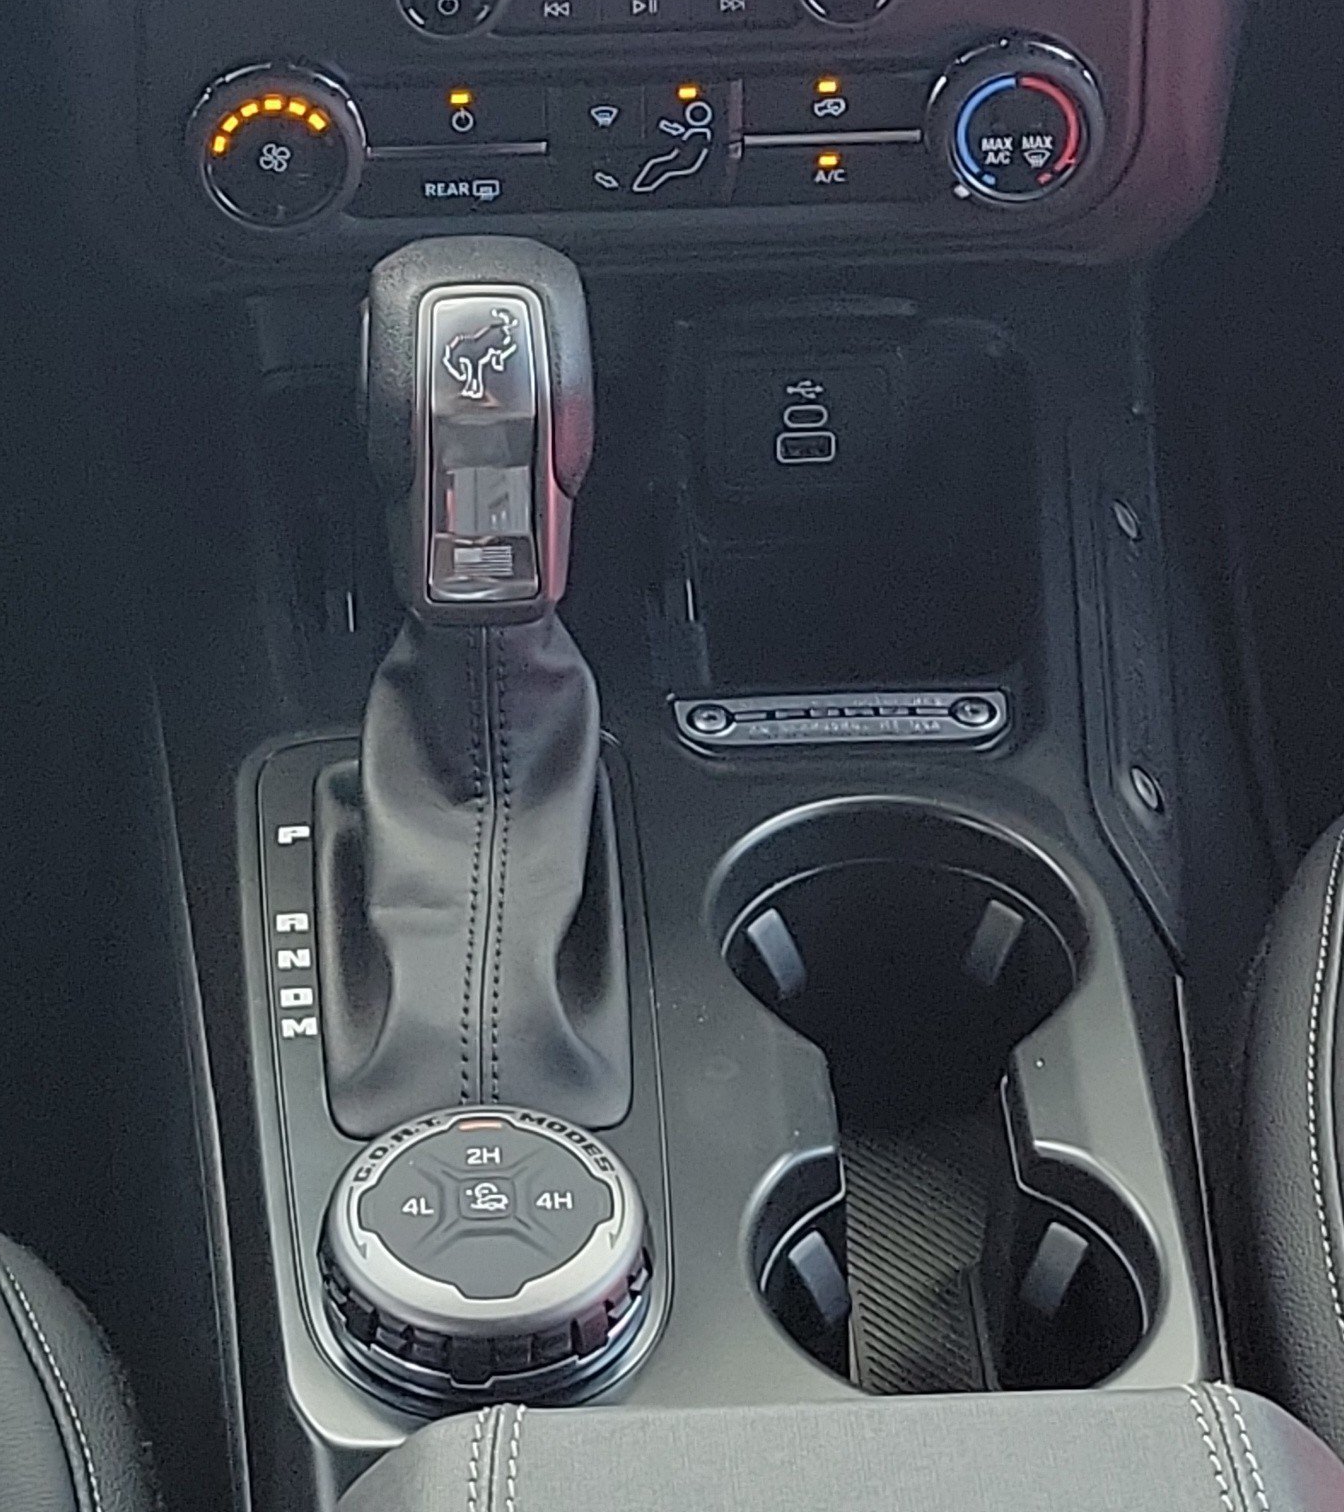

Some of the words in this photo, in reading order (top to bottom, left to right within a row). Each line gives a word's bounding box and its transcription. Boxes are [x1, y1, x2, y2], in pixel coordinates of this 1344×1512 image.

[981, 136, 1013, 152] MAX
[1021, 134, 1052, 151] MAX
[984, 151, 1011, 165] A/C
[814, 167, 846, 185] A/C
[423, 180, 471, 197] REAR
[278, 826, 310, 844] P
[276, 913, 309, 932] R
[277, 948, 311, 970] N
[280, 988, 313, 1008] D
[281, 1017, 318, 1038] M
[517, 1111, 616, 1173] MODES
[465, 1147, 501, 1165] 2H
[401, 1197, 434, 1216] 4L
[535, 1192, 573, 1211] 4H
